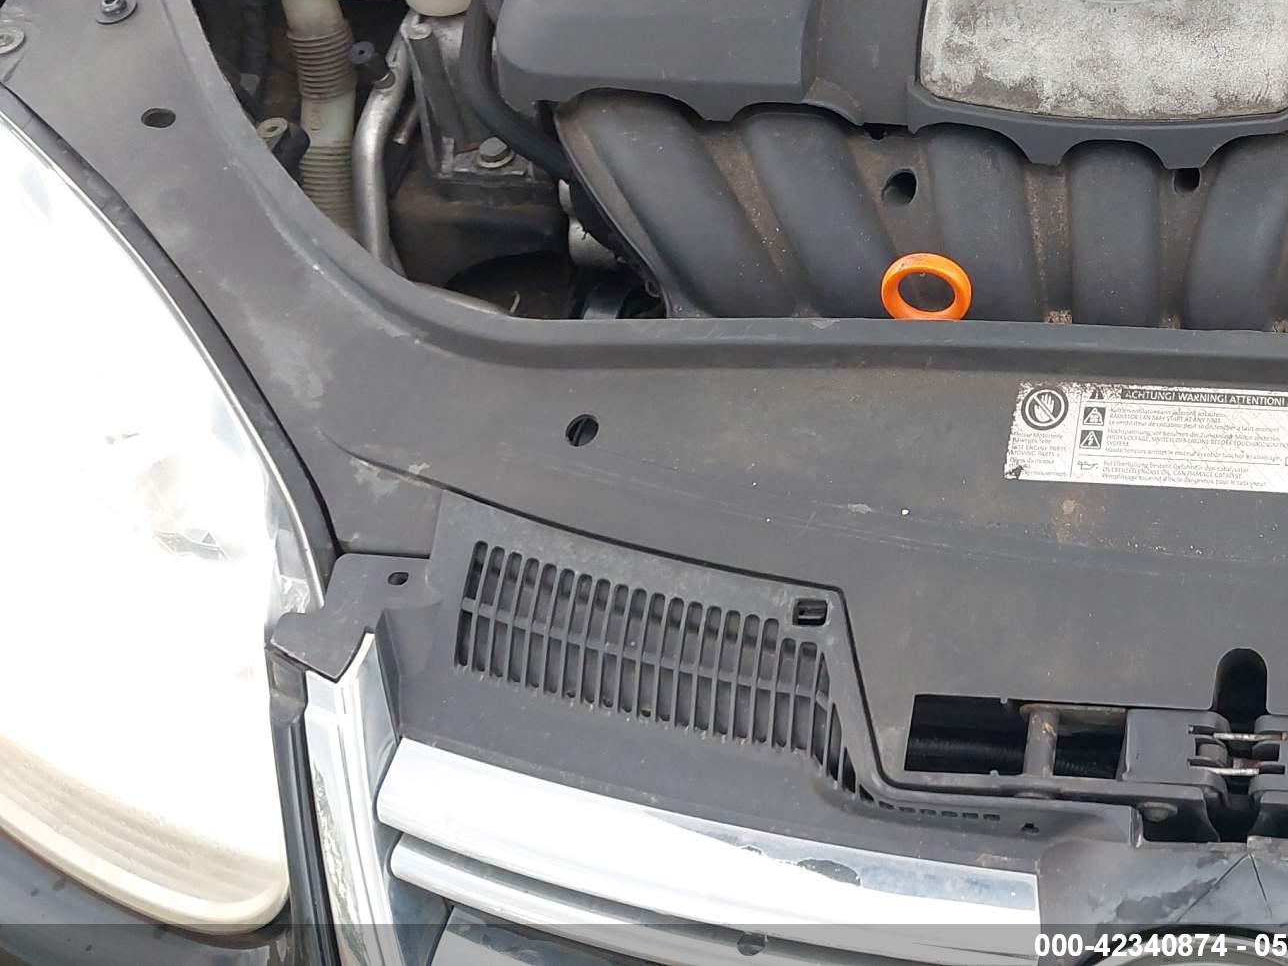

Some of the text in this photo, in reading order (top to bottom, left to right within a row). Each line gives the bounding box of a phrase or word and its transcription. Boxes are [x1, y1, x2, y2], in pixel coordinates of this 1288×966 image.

[1125, 390, 1285, 405] ACHTUNG! WARNING! ATTENTION!
